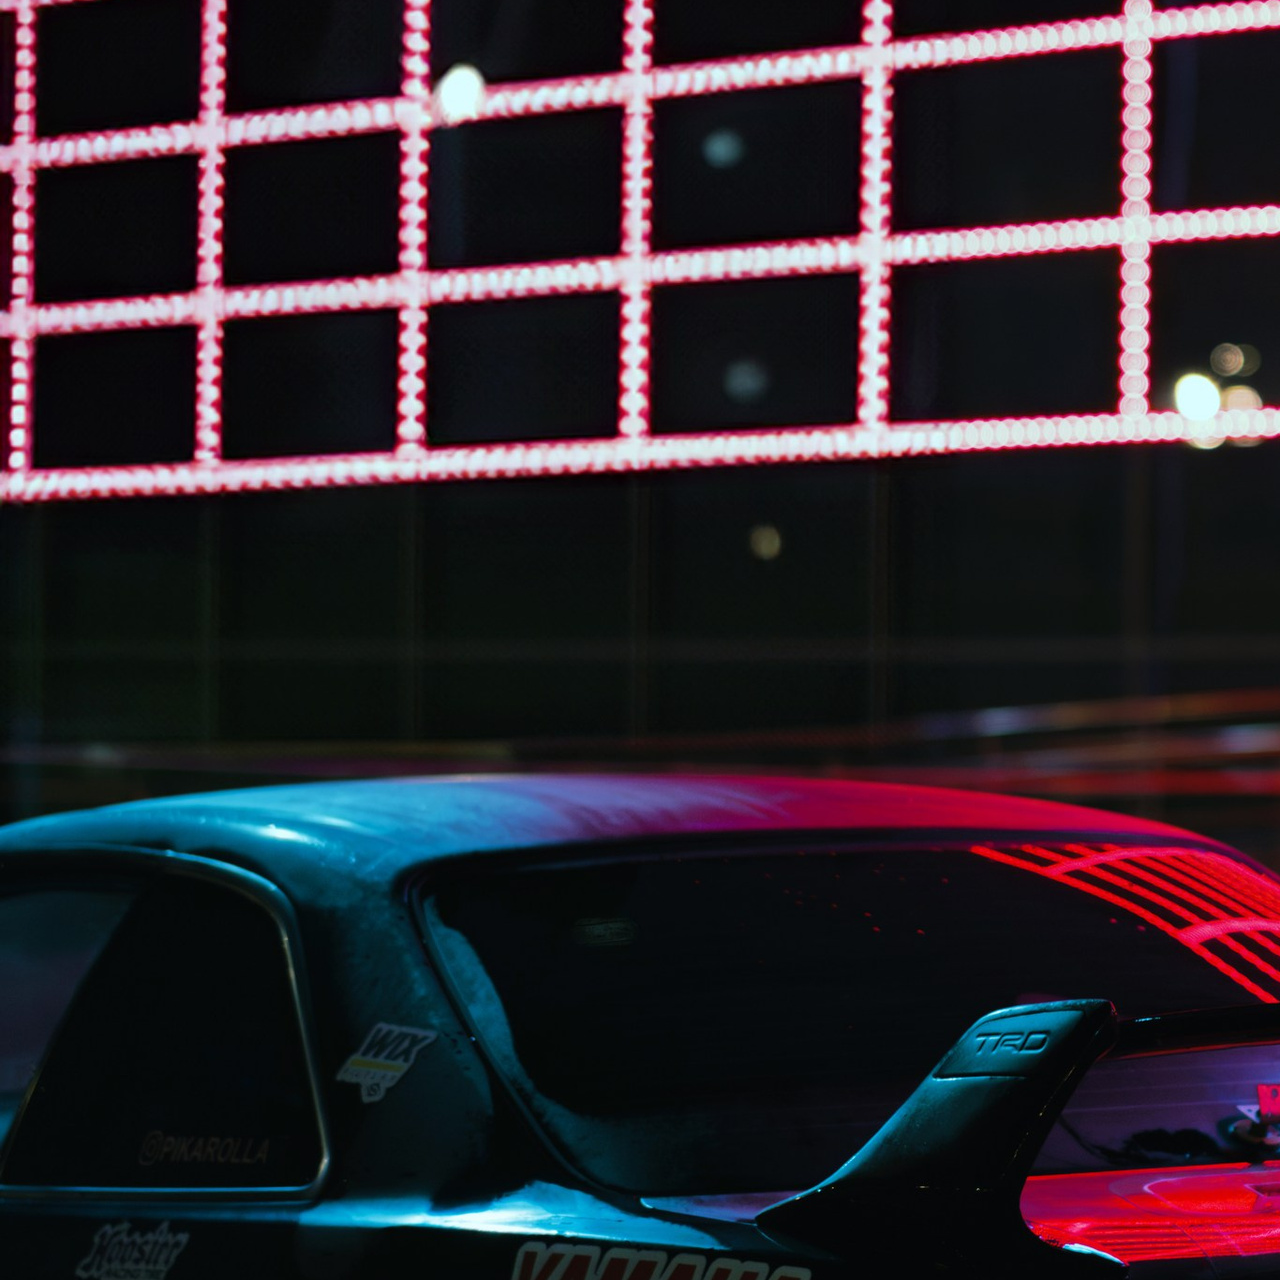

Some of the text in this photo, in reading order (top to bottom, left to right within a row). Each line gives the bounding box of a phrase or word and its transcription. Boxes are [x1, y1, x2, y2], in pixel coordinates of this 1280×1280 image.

[361, 1028, 429, 1063] WIX
[976, 1031, 1050, 1054] TRD
[138, 1130, 270, 1166] @PIKAROLLA
